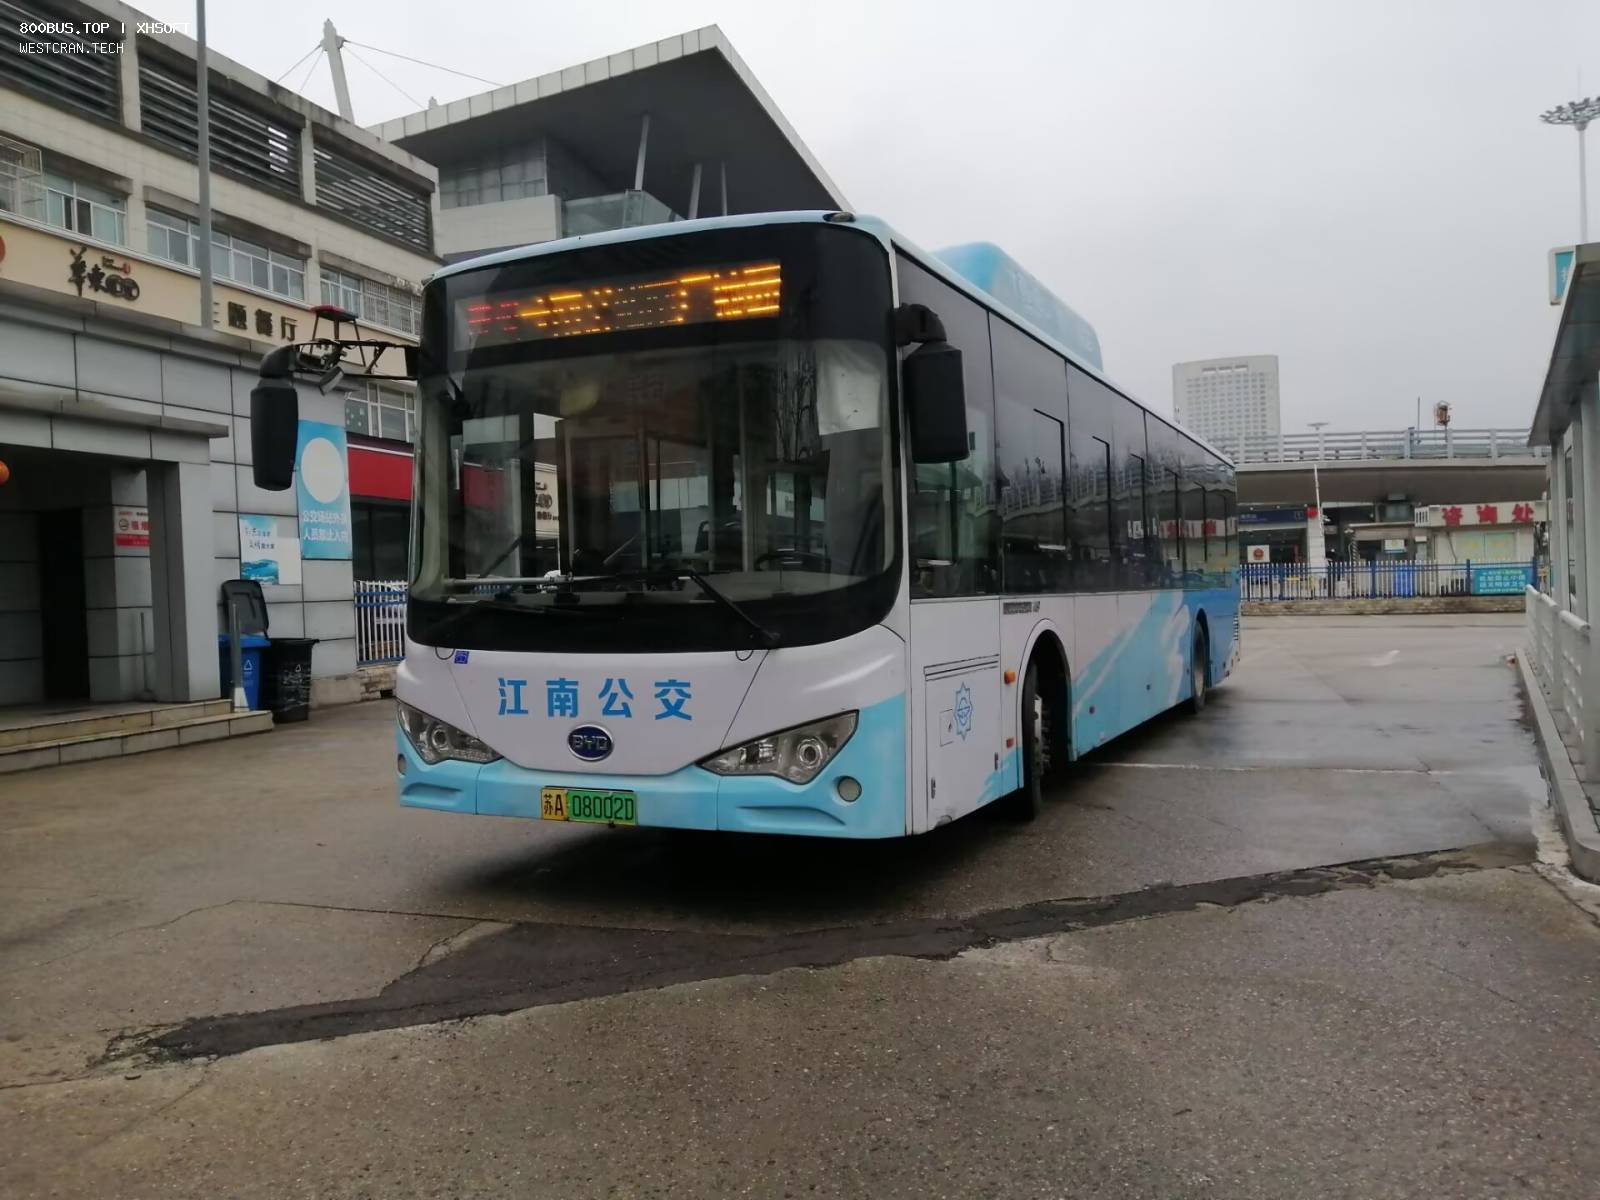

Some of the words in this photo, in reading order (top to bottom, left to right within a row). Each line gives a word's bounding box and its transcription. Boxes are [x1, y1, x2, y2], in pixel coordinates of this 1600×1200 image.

[497, 677, 693, 721] 江南公交
[572, 734, 609, 750] BYD
